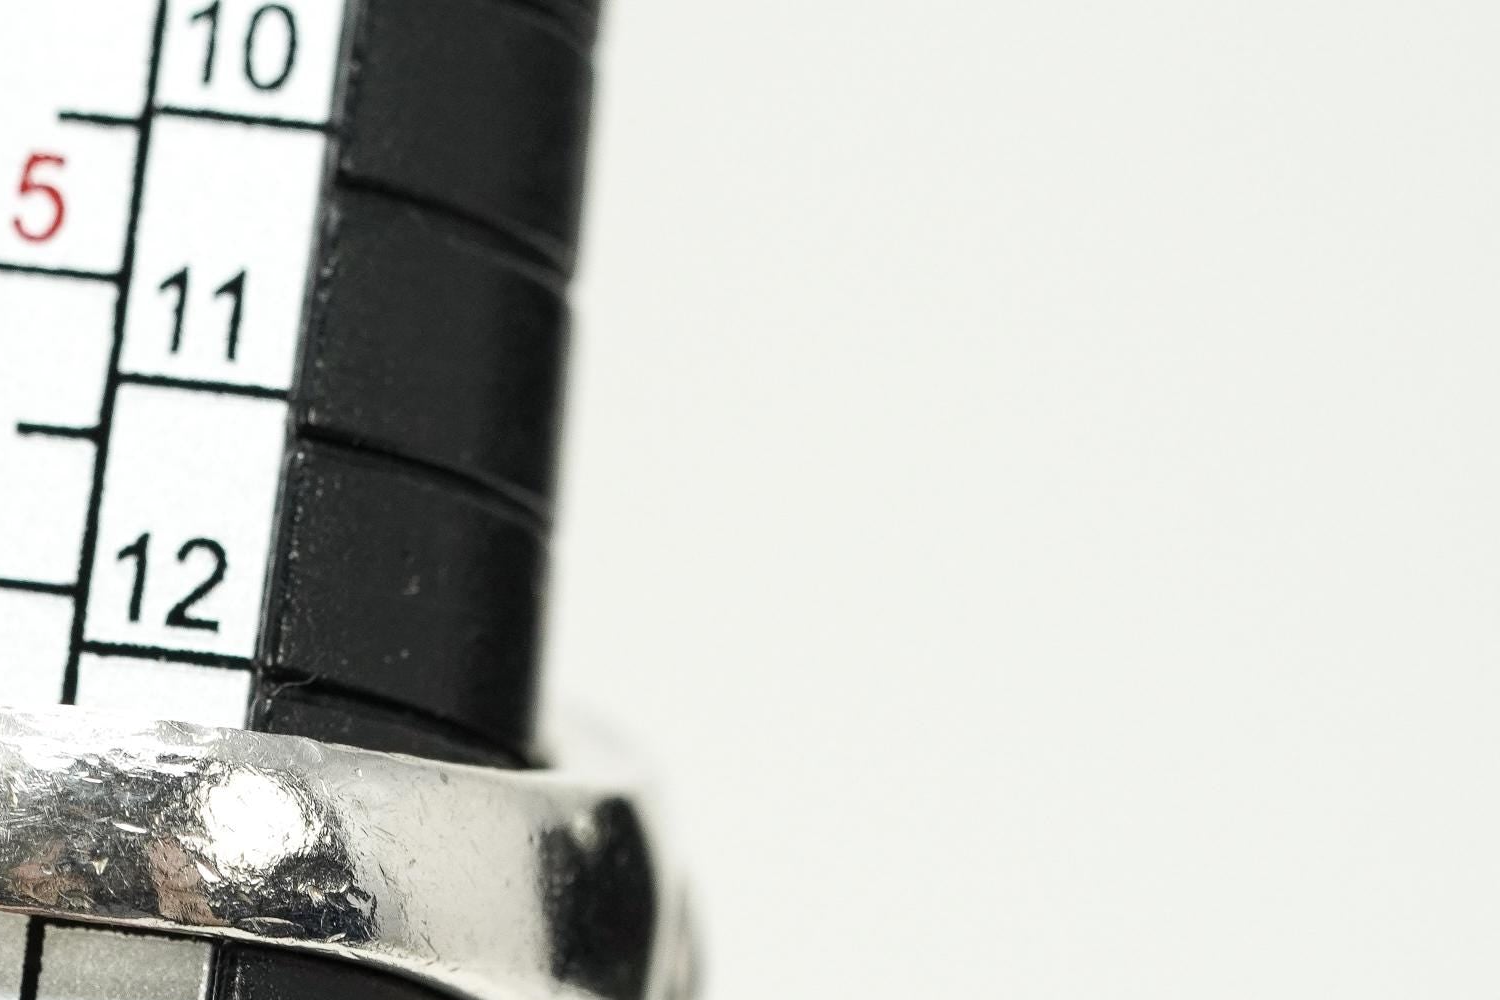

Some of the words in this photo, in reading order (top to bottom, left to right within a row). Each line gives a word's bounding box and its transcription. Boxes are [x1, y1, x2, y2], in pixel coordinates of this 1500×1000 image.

[187, 0, 298, 90] 10
[12, 152, 66, 243] 5
[158, 266, 247, 362] 11
[116, 532, 229, 633] 12
